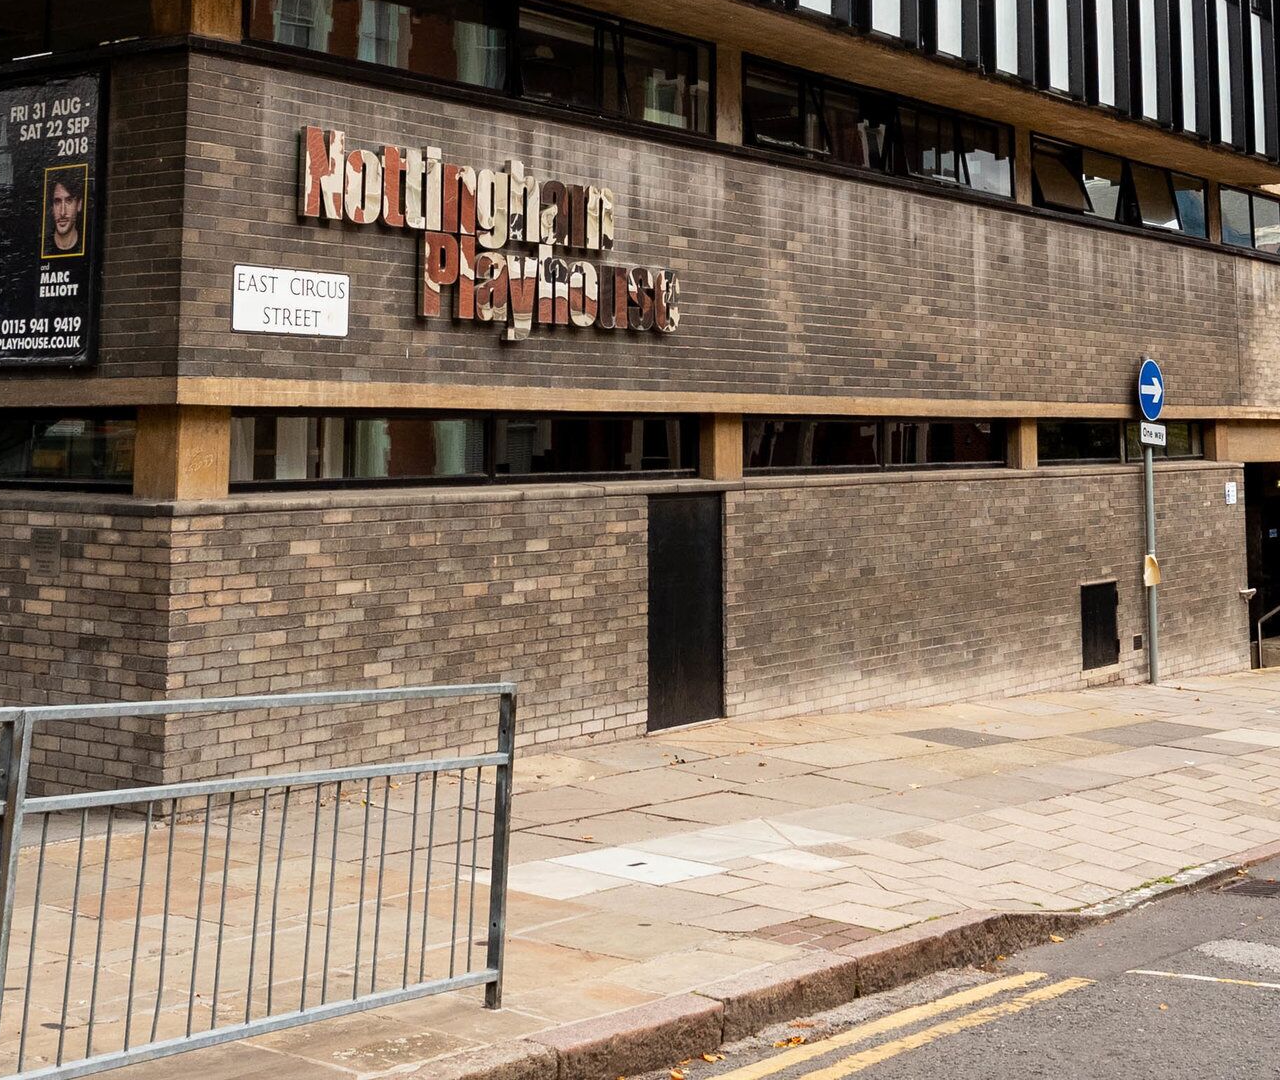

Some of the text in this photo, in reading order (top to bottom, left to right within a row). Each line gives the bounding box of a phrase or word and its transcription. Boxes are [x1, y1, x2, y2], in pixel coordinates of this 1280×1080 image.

[10, 105, 29, 123] FRI
[32, 102, 46, 120] 31
[51, 96, 81, 117] AUG
[20, 116, 90, 142] SAT 22 SEP
[57, 136, 89, 157] 2018
[298, 125, 614, 251] Nottingham
[40, 262, 50, 271] and
[40, 271, 70, 284] MARC
[237, 273, 345, 299] EAST CIRCUS
[418, 231, 681, 342] Playhouse
[39, 284, 79, 298] ELLIOTT
[1, 319, 26, 335] 0115
[29, 318, 49, 334] 941
[54, 316, 81, 332] 9419
[262, 306, 321, 328] STREET
[1143, 427, 1164, 441] One way
